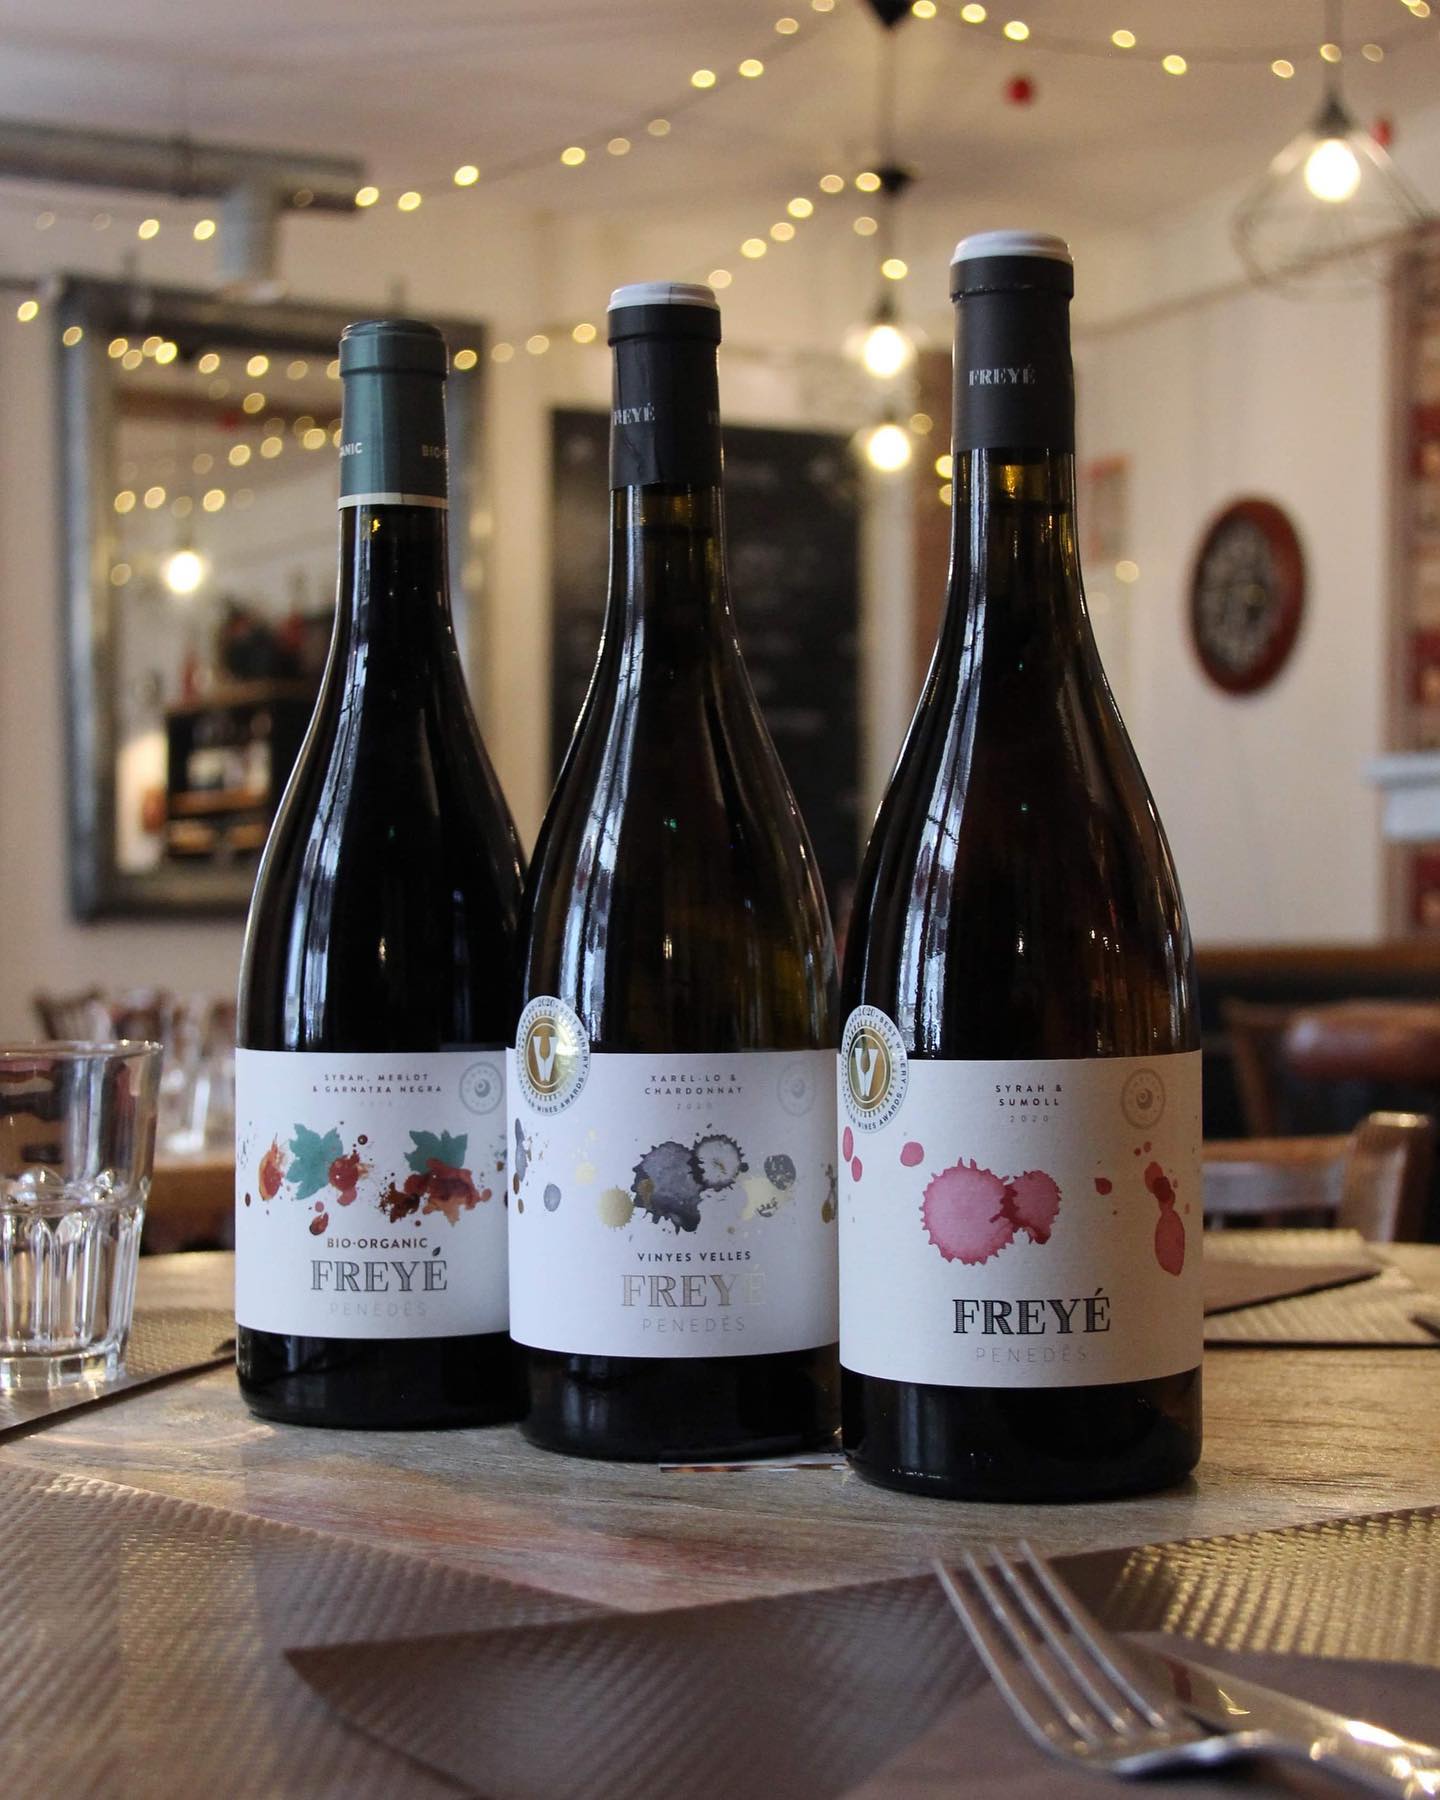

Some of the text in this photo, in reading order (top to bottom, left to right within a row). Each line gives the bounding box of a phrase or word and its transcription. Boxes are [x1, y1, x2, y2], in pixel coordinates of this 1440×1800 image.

[969, 364, 1036, 386] FREYÉ
[611, 403, 655, 426] REYÉ
[377, 1073, 429, 1081] MERLOT
[730, 1074, 737, 1082] &
[312, 1085, 318, 1093] &
[400, 1085, 442, 1093] NEGRA
[560, 1077, 584, 1108] AWARDS
[644, 1087, 744, 1095] CHARDONNAY
[995, 1084, 1063, 1093] SYRAH &
[999, 1098, 1060, 1106] SUMOLL
[879, 1092, 903, 1126] AWARDS
[1010, 1114, 1049, 1122] 2020
[637, 1250, 752, 1262] VINYES VELLES
[310, 1247, 448, 1292] FREYÉ
[621, 1263, 766, 1307] FREYÉ
[952, 1288, 1111, 1335] FREYÉ
